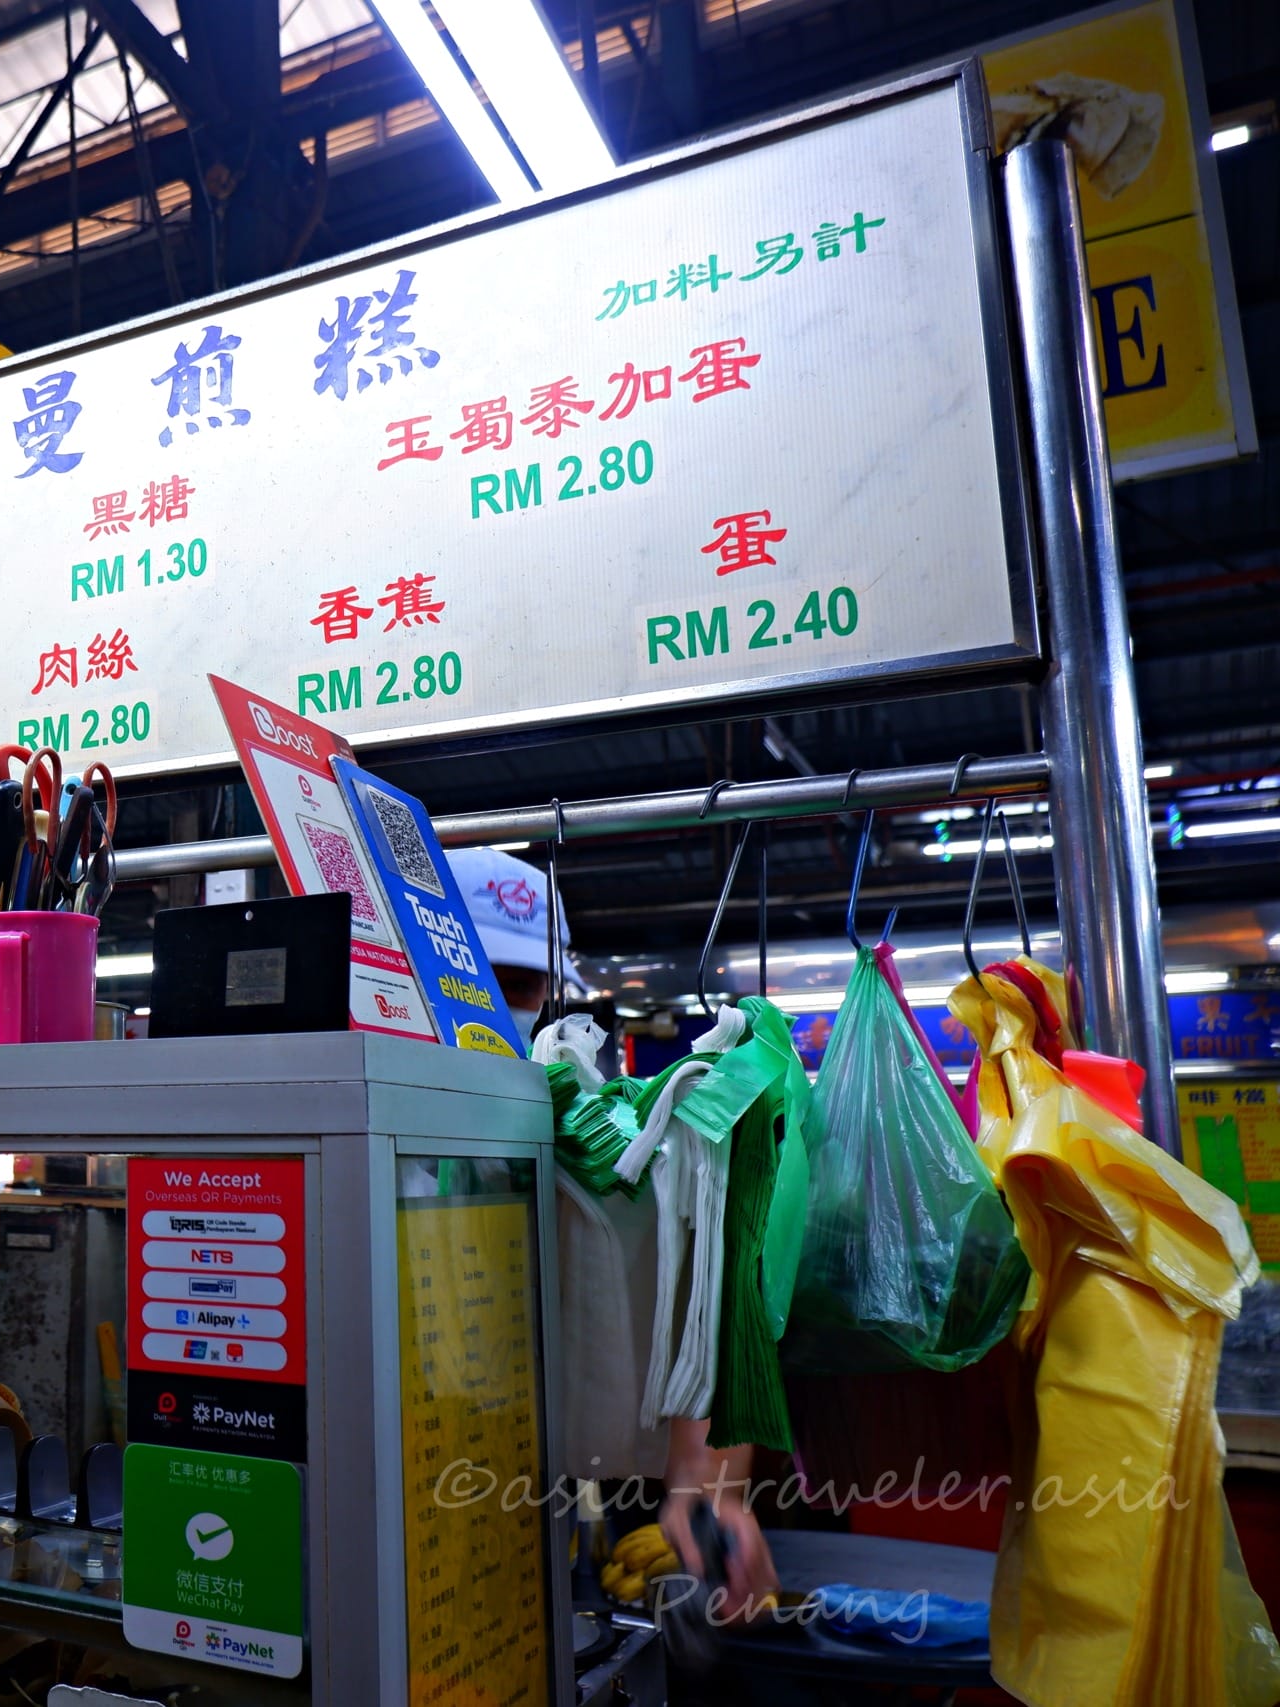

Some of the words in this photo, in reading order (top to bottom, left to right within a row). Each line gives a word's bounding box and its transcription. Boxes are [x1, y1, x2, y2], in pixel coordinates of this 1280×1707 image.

[597, 212, 886, 321] 加料另計
[14, 268, 440, 478] 曼煎糕
[377, 337, 762, 471] 玉蜀黍加蛋
[83, 474, 196, 540] 黑糖
[470, 463, 543, 519] RM
[557, 439, 655, 501] 2.80
[70, 555, 124, 602] RM
[137, 537, 208, 587] 1.30
[700, 509, 788, 576] 蛋
[310, 572, 446, 645] 香蕉
[646, 606, 730, 664] RM
[746, 586, 859, 650] 2.40
[30, 627, 139, 695] 肉絲
[297, 664, 363, 716] RM
[375, 650, 463, 705] 2.80
[18, 714, 70, 752] RM
[80, 701, 151, 750] 2.80
[248, 700, 319, 760] Boost
[404, 892, 468, 945] Touch
[374, 994, 412, 1020] Boost
[438, 973, 496, 1012] eWallet
[1181, 1034, 1260, 1059] FRUIT
[145, 1190, 198, 1204] Overseas
[201, 1191, 220, 1204] QR
[223, 1192, 283, 1206] Payments
[164, 1171, 193, 1187] We
[198, 1171, 262, 1191] Accept
[191, 1249, 233, 1264] NETS
[213, 1406, 276, 1430] PayNet
[176, 1569, 245, 1599] 微信支付
[177, 1590, 221, 1609] WeChat
[224, 1598, 245, 1616] Pay
[223, 1637, 275, 1660] PayNet
